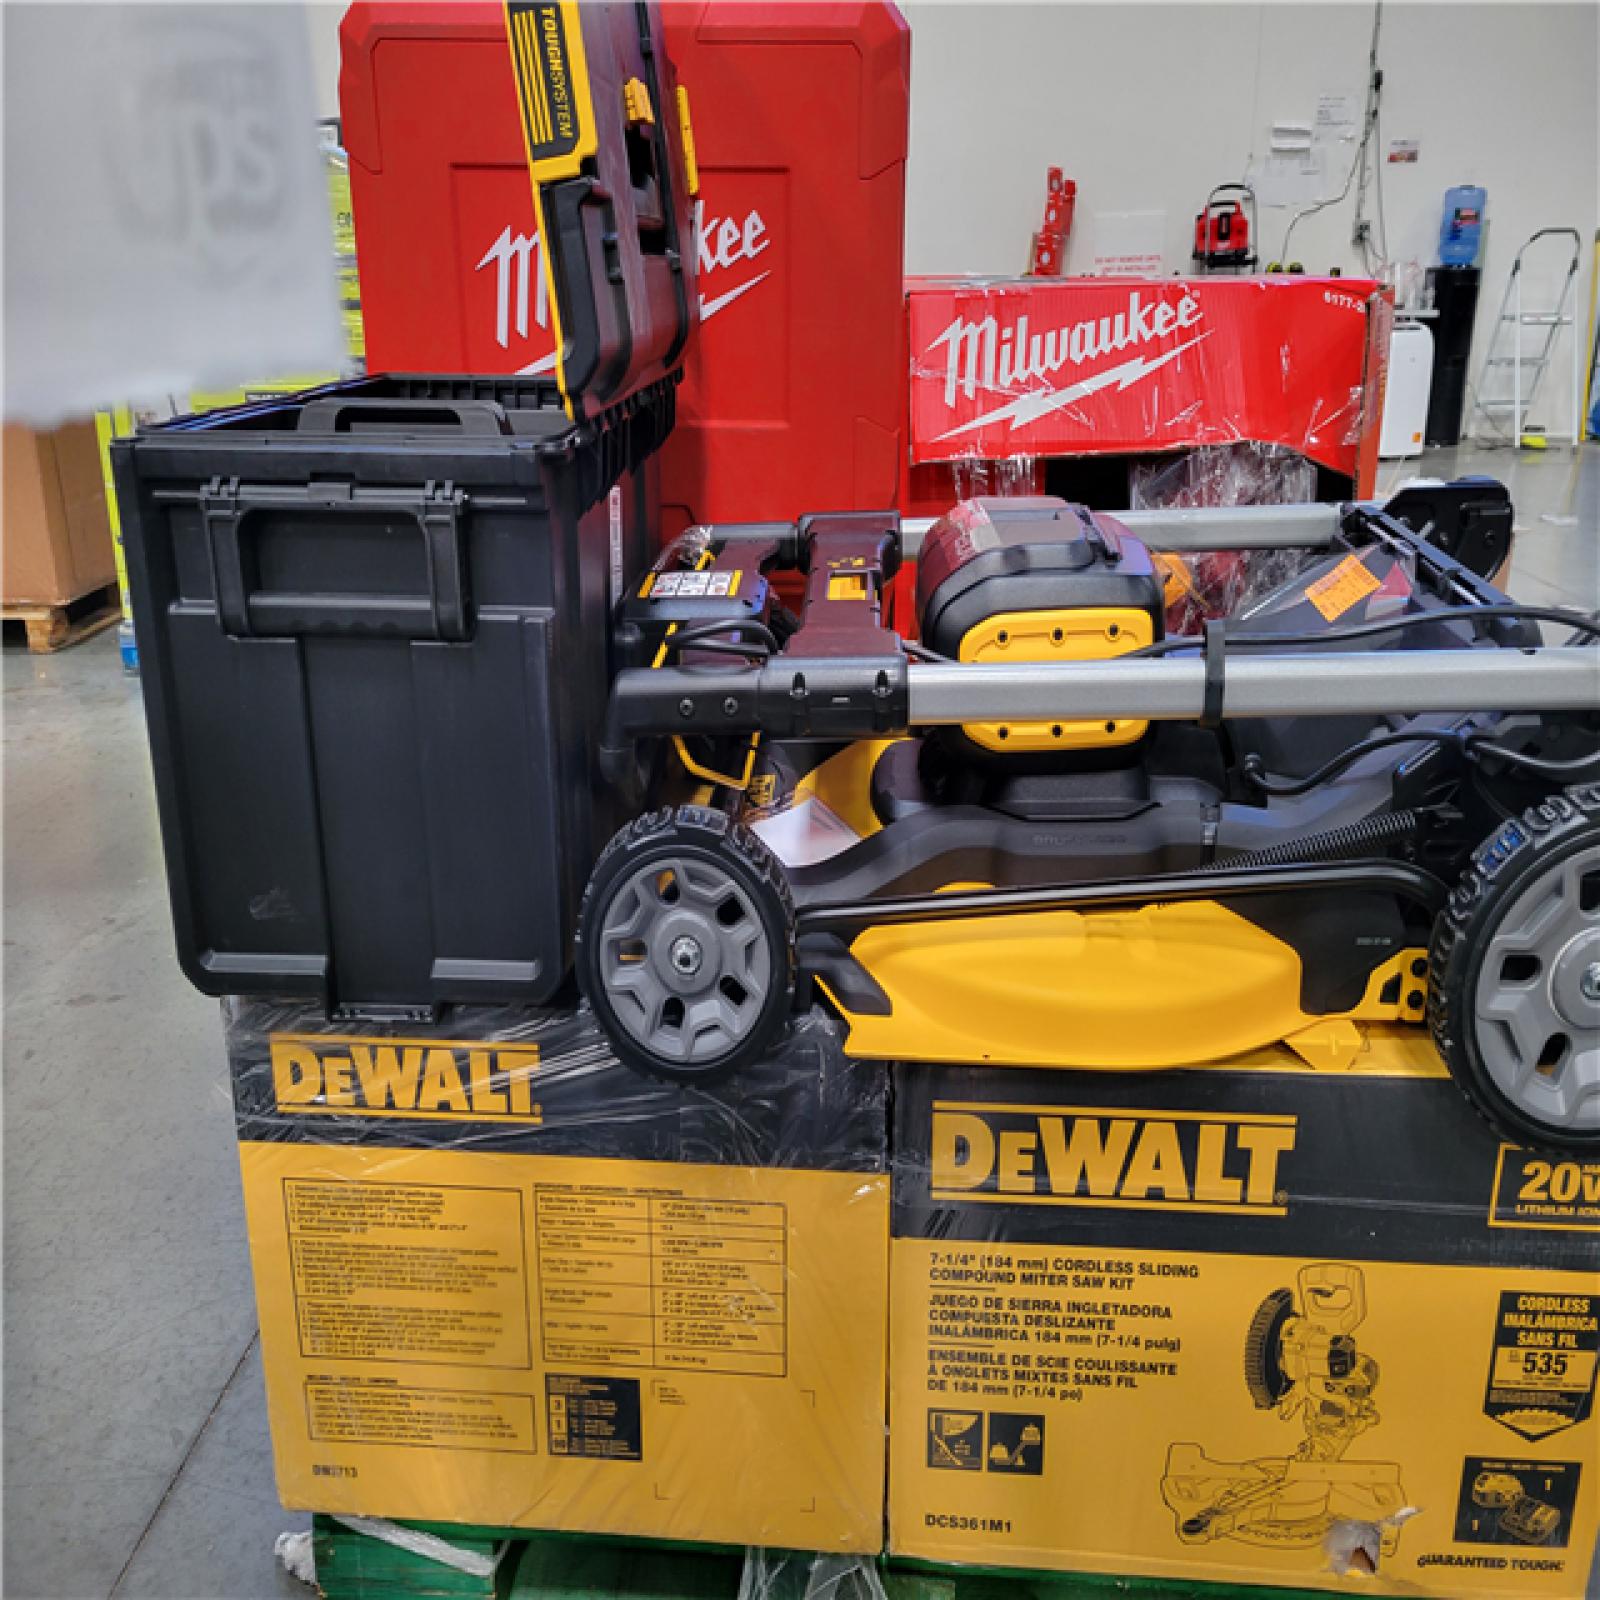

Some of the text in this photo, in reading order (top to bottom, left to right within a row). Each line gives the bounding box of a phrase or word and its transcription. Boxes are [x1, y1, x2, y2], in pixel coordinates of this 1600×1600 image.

[541, 7, 573, 138] TOUGHSYSTEM
[927, 291, 1204, 408] Milwaukee
[272, 1043, 541, 1114] DEWALT
[932, 1112, 1296, 1205] DEWALT
[1053, 1258, 1133, 1274] CORDLESS
[1138, 1262, 1200, 1278] SLIDING
[930, 1269, 1134, 1290] COMPOUND MITER SAW KIT
[930, 1295, 1172, 1318] JUEGO DE SIERRA INGLETADORA
[1518, 1295, 1590, 1313] CORDLESS
[929, 1310, 1116, 1330] COMPUESTA DESLIZANTE
[1517, 1331, 1578, 1347] SANS FIL
[928, 1350, 1178, 1376] ENSEMBLE DE SCIE COULISSANTE
[1522, 1352, 1568, 1375] 535
[928, 1379, 948, 1391] DE
[942, 1366, 1009, 1380] ONGLETS
[1014, 1369, 1068, 1384] MIXTES
[1072, 1373, 1111, 1386] SANS
[1117, 1376, 1138, 1388] FIL
[925, 1513, 1011, 1533] DCS361M1
[1417, 1553, 1507, 1569] GUARANTEED
